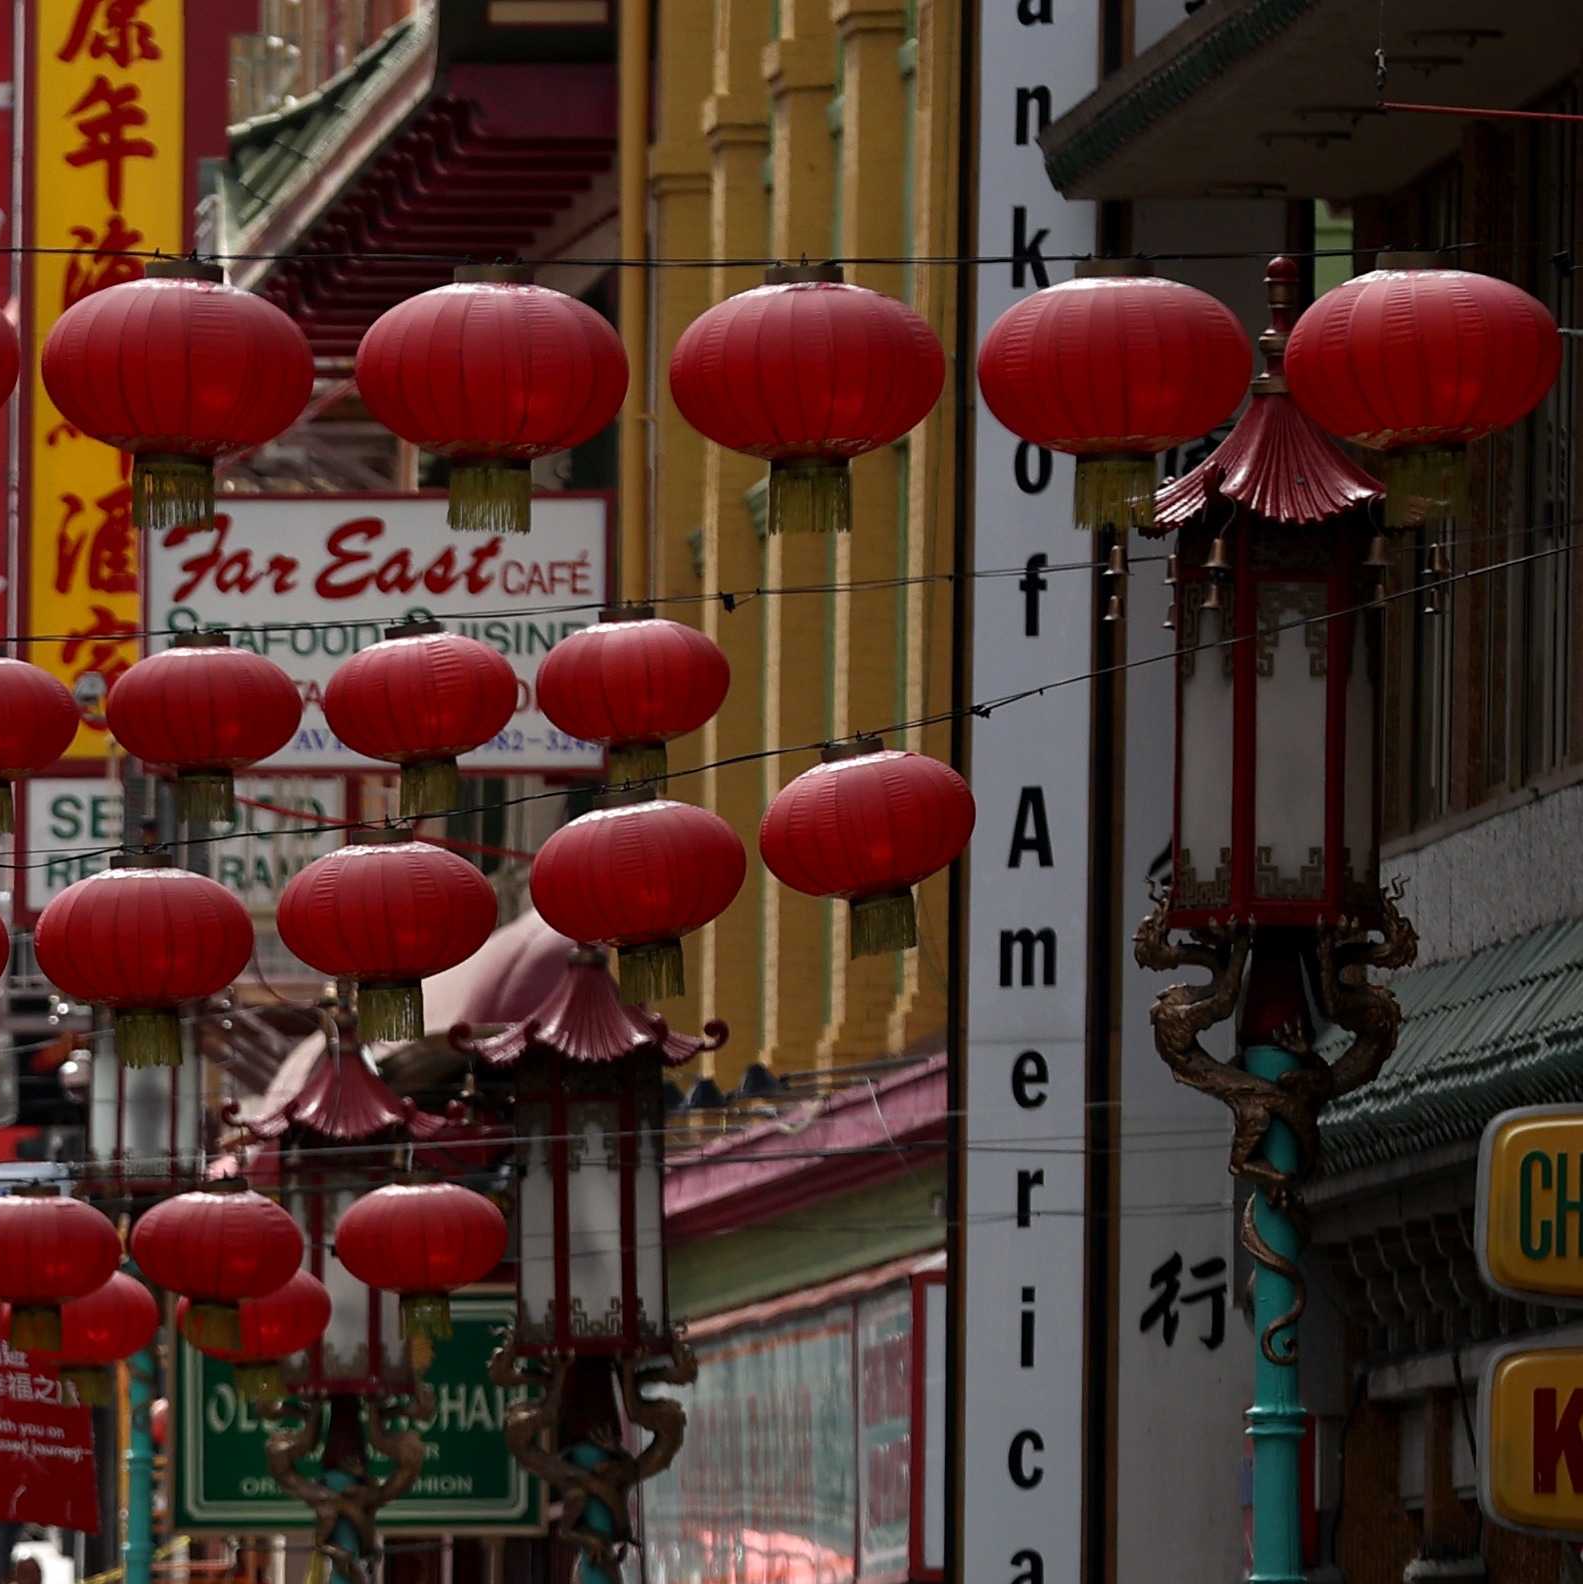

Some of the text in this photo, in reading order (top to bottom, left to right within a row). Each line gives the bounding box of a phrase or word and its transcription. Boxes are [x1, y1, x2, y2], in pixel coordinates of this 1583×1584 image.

[163, 513, 593, 602] Far East CAFÉ
[20, 1423, 45, 1437] you
[48, 1427, 65, 1440] on
